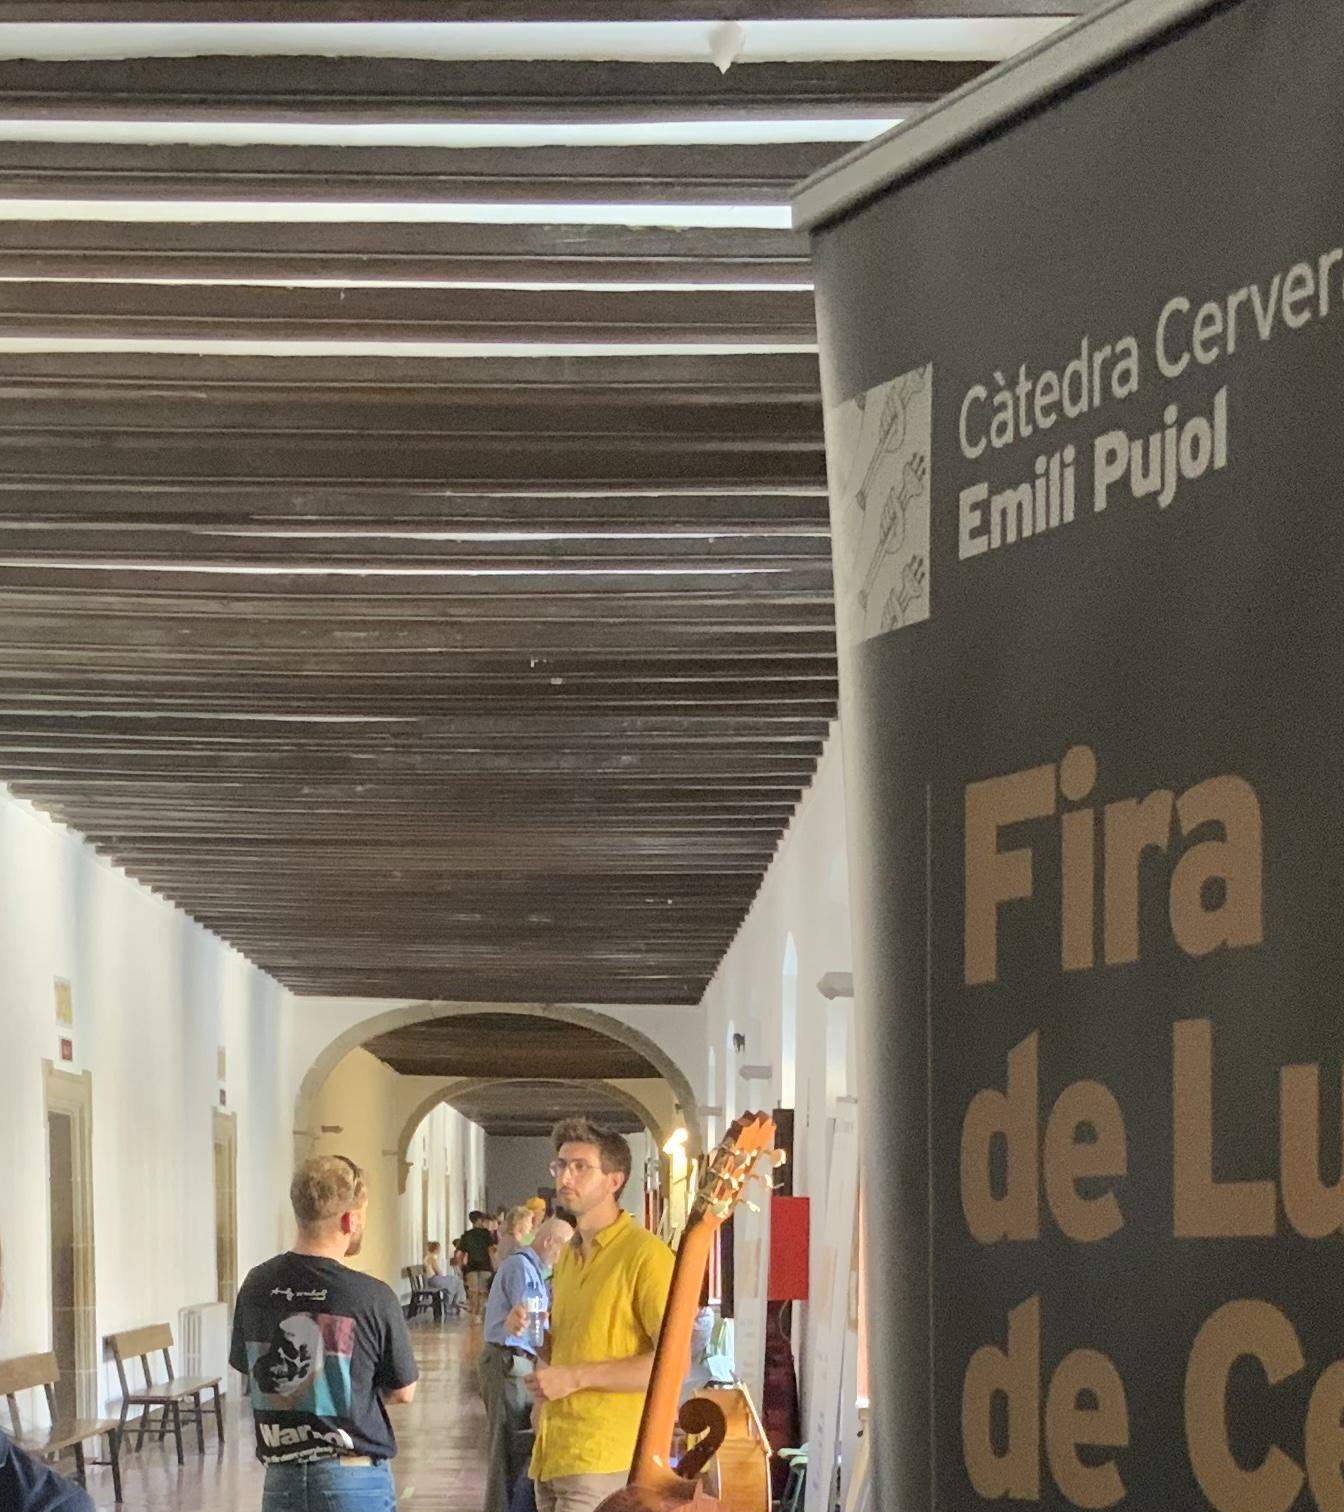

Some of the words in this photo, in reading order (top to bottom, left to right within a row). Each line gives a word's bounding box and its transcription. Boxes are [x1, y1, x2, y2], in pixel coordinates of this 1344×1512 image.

[958, 443, 1075, 561] Emili
[1093, 384, 1228, 511] Pujol
[959, 335, 1139, 459] Càtedra
[964, 744, 1264, 986] Fira
[959, 1029, 1128, 1244] de
[960, 1293, 1129, 1510] de
